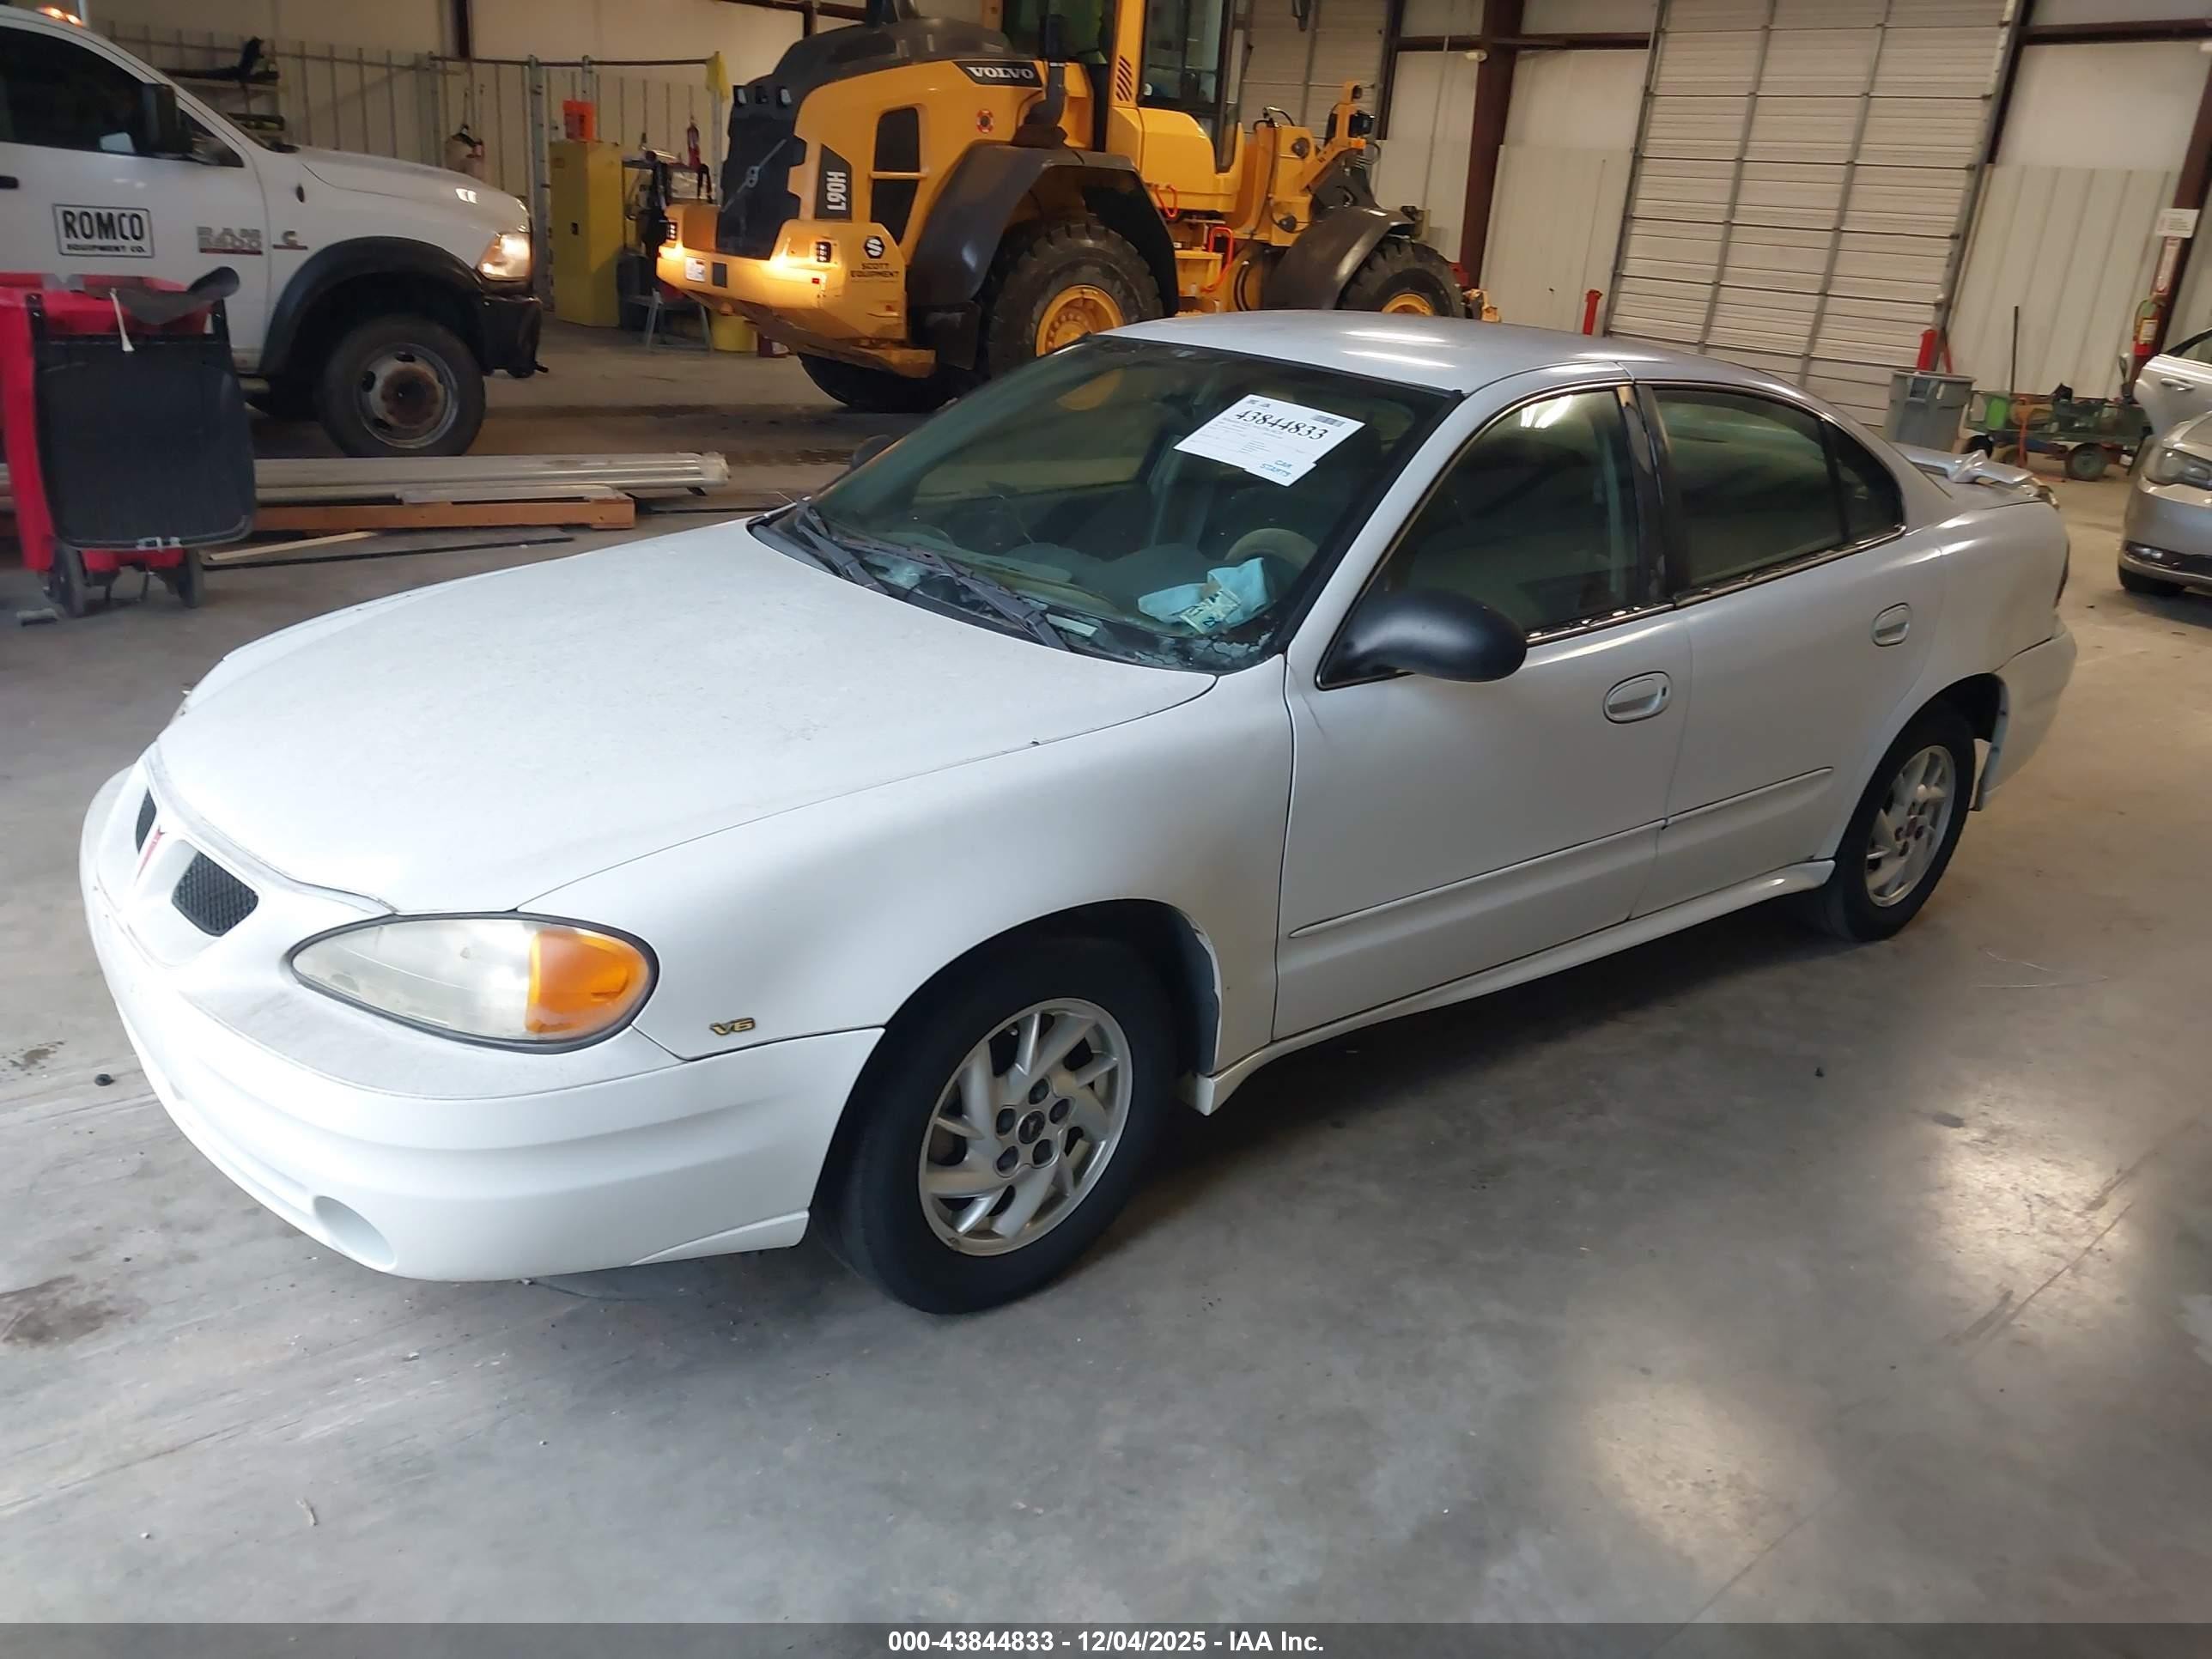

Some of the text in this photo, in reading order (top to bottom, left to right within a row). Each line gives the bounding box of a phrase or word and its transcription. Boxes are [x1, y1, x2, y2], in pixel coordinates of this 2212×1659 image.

[966, 66, 1034, 79] VOLVO
[826, 171, 847, 211] L90H
[63, 210, 144, 240] ROMCO
[1235, 410, 1328, 440] 43844833
